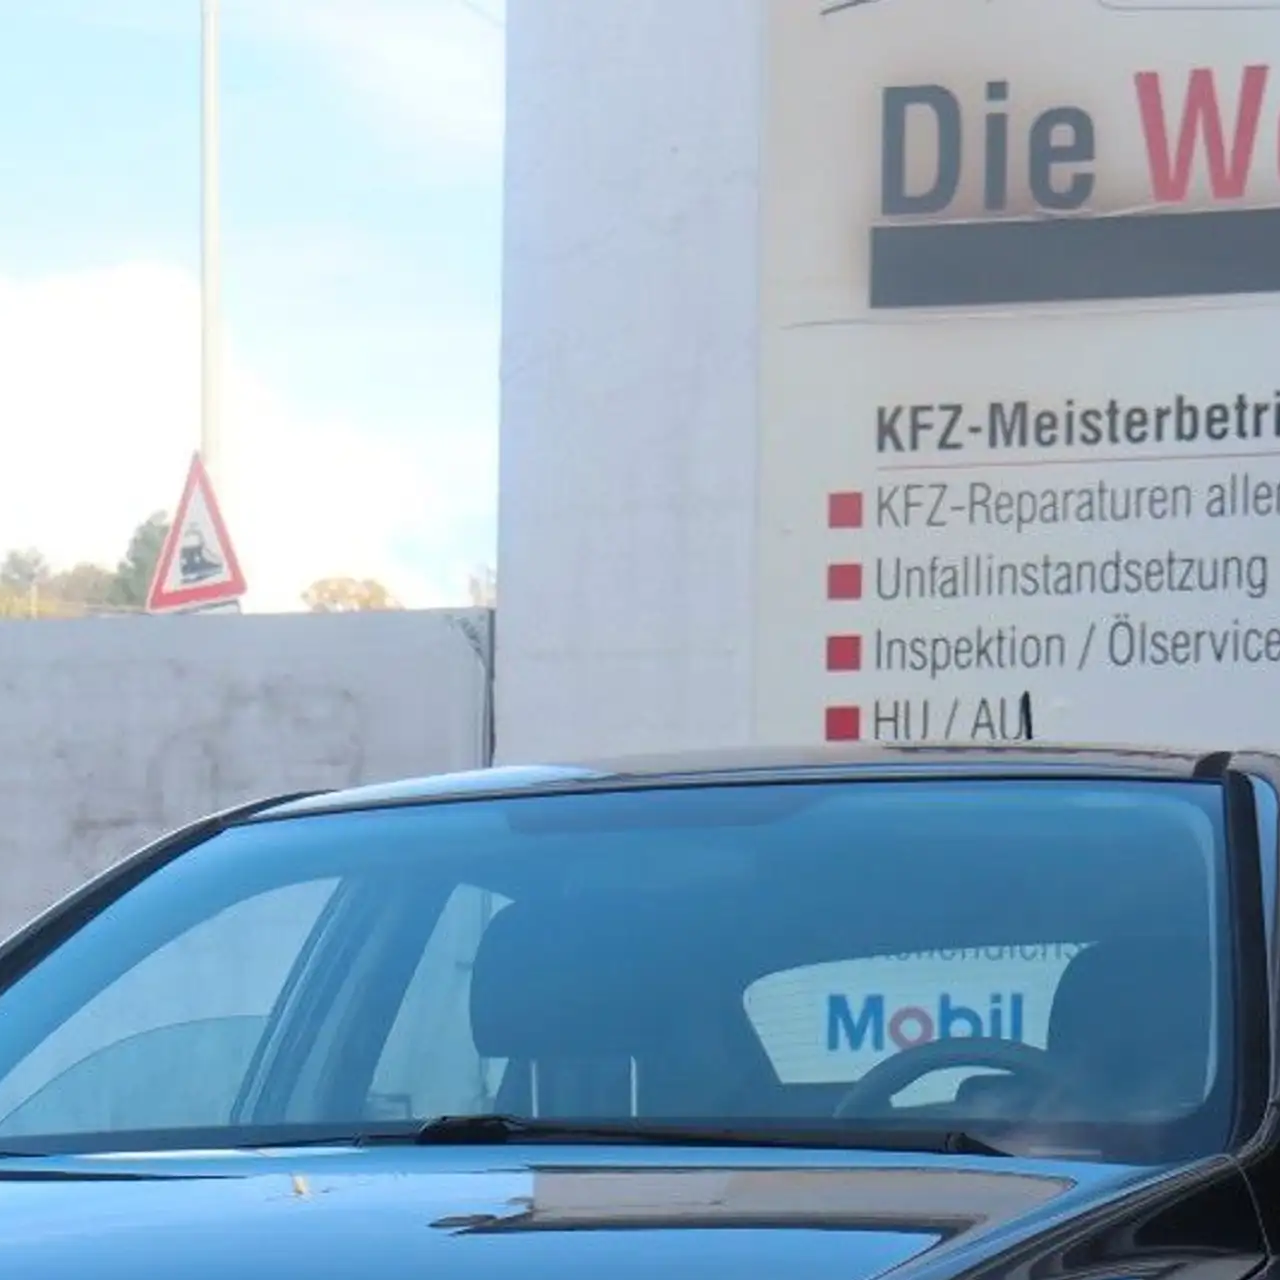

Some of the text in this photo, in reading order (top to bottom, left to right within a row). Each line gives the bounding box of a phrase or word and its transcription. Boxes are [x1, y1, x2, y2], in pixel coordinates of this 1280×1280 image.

[880, 81, 1096, 215] Die
[875, 478, 1192, 531] KFZ-Reparaturen
[875, 550, 1268, 600] Unfallinstandsetzung
[874, 625, 1065, 678] Inspektion
[828, 992, 1024, 1050] Mobil
